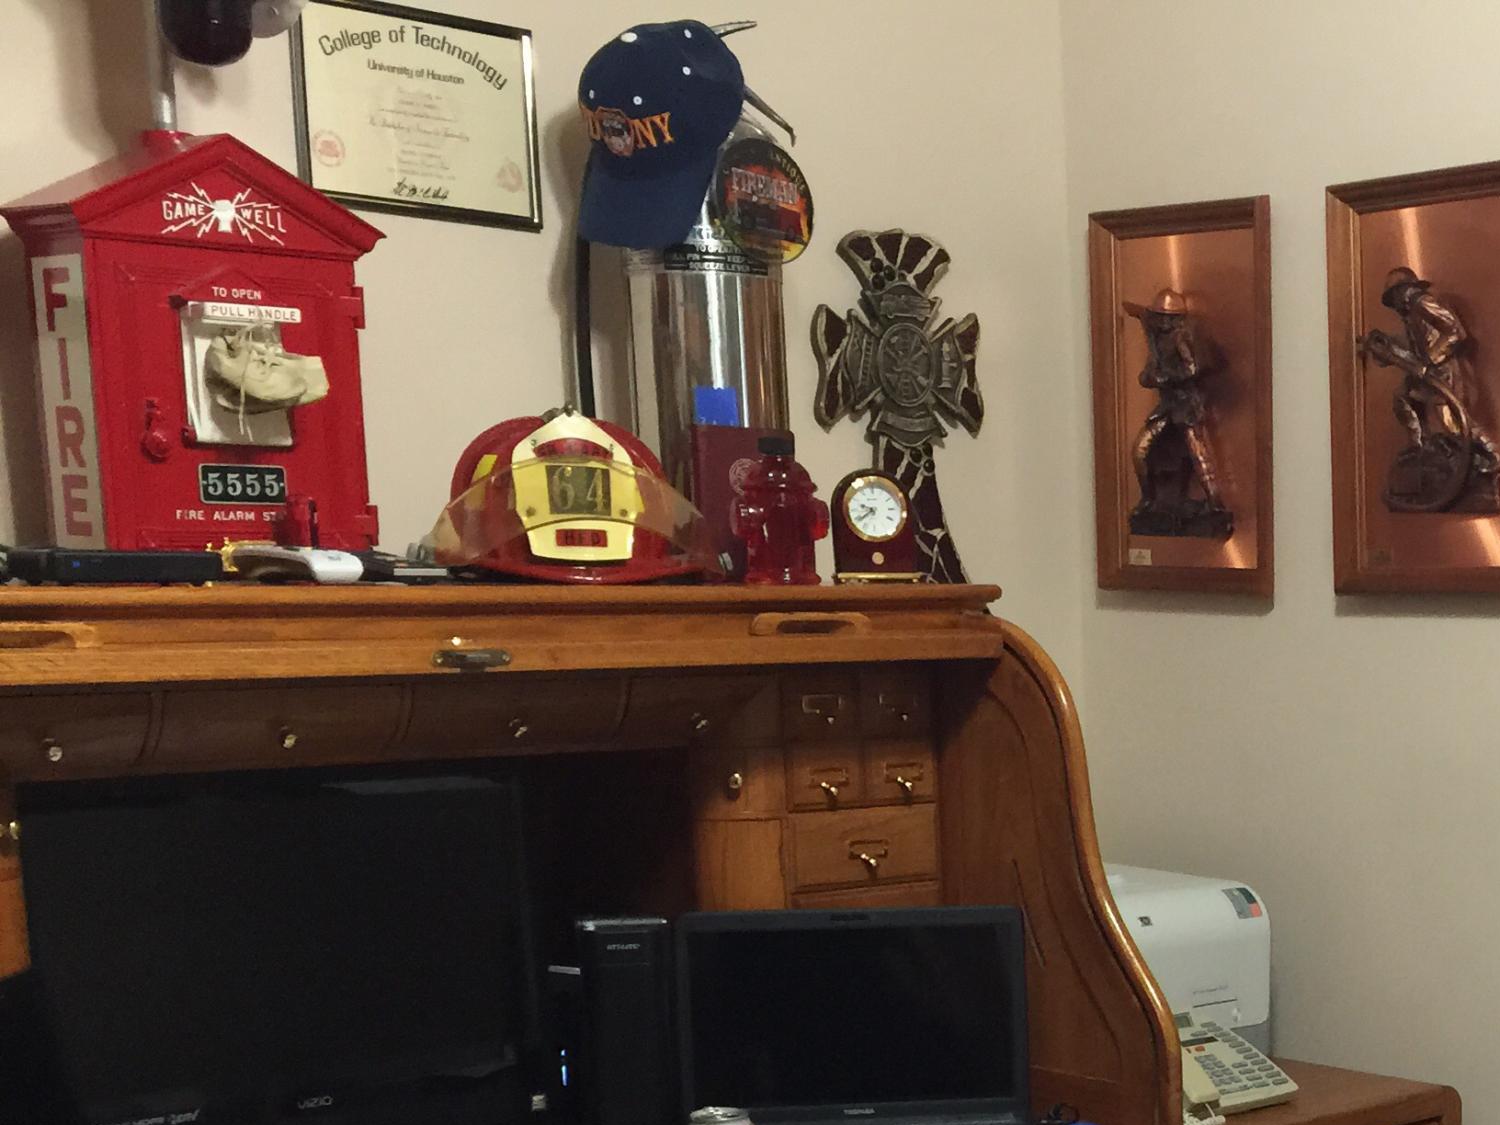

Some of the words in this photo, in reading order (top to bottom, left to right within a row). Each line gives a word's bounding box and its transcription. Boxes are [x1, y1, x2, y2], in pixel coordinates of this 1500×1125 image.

[318, 28, 382, 56] College
[388, 26, 406, 44] of
[412, 26, 508, 91] Technology
[367, 58, 414, 79] University
[415, 68, 425, 78] of
[426, 69, 465, 84] Houston
[162, 200, 206, 221] GAME
[240, 208, 288, 233] WELL
[211, 286, 228, 298] TO
[231, 288, 262, 300] OPEN
[210, 304, 244, 317] PULL
[248, 308, 298, 321] HANDLE
[42, 266, 93, 537] FIRE
[207, 472, 281, 497] 5555
[551, 464, 606, 515] 64
[175, 509, 205, 521] FIRE
[213, 510, 256, 521] ALARM
